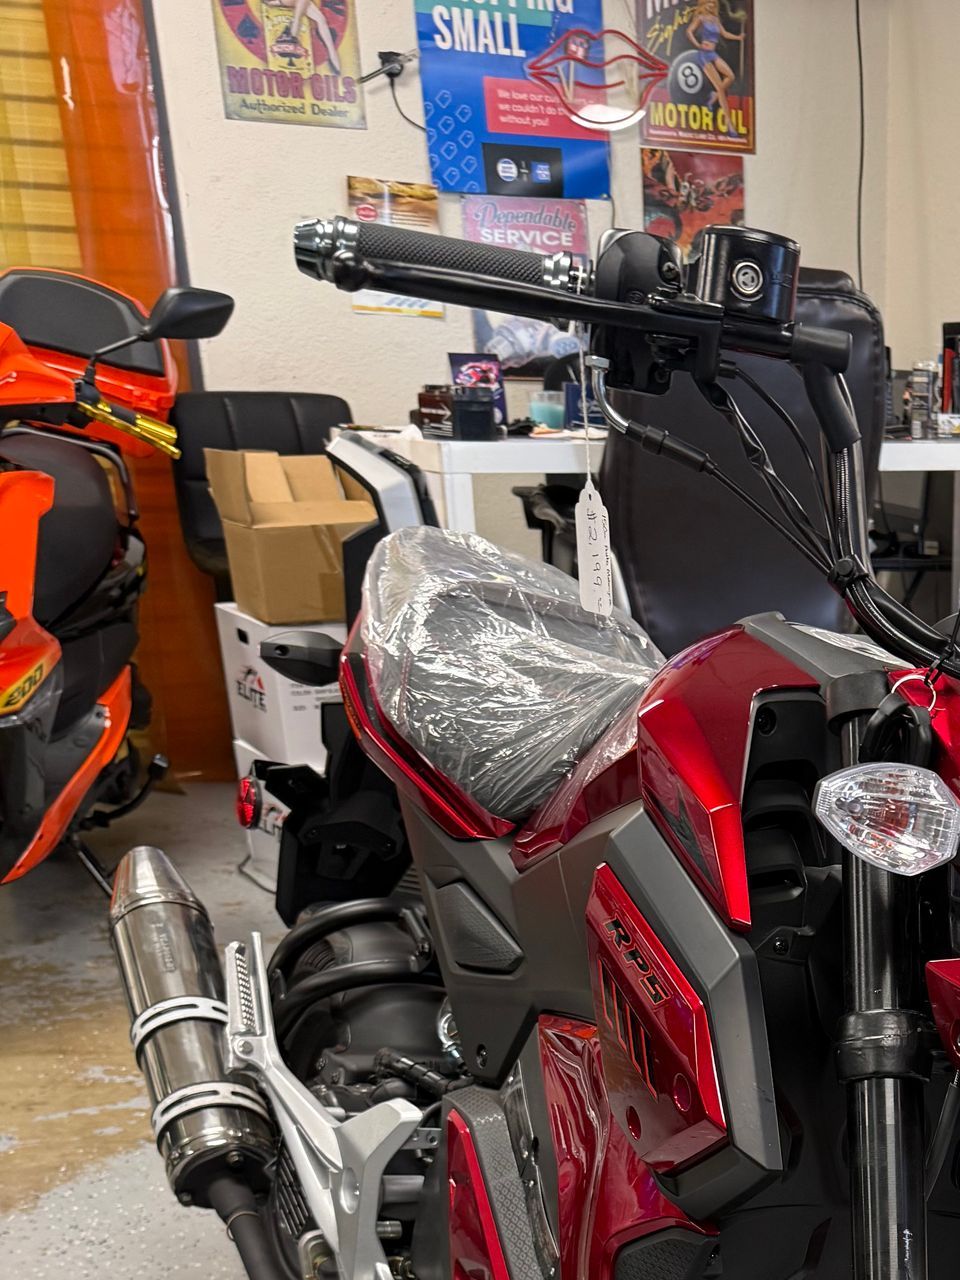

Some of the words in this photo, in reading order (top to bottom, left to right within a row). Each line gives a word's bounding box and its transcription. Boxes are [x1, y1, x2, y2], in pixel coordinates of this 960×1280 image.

[432, 5, 526, 57] SMALL
[226, 66, 304, 99] MOTOR
[311, 73, 356, 104] OILS
[497, 89, 510, 98] We
[512, 91, 528, 100] love
[530, 93, 544, 101] our
[240, 98, 304, 115] Authorized
[311, 103, 349, 117] Dealer
[512, 104, 545, 114] couldn't
[650, 102, 713, 130] MOTOR
[499, 115, 531, 125] without
[532, 119, 549, 128] you!
[474, 201, 577, 232] Dependable
[480, 229, 573, 247] SERVICE
[236, 679, 266, 708] ELITE
